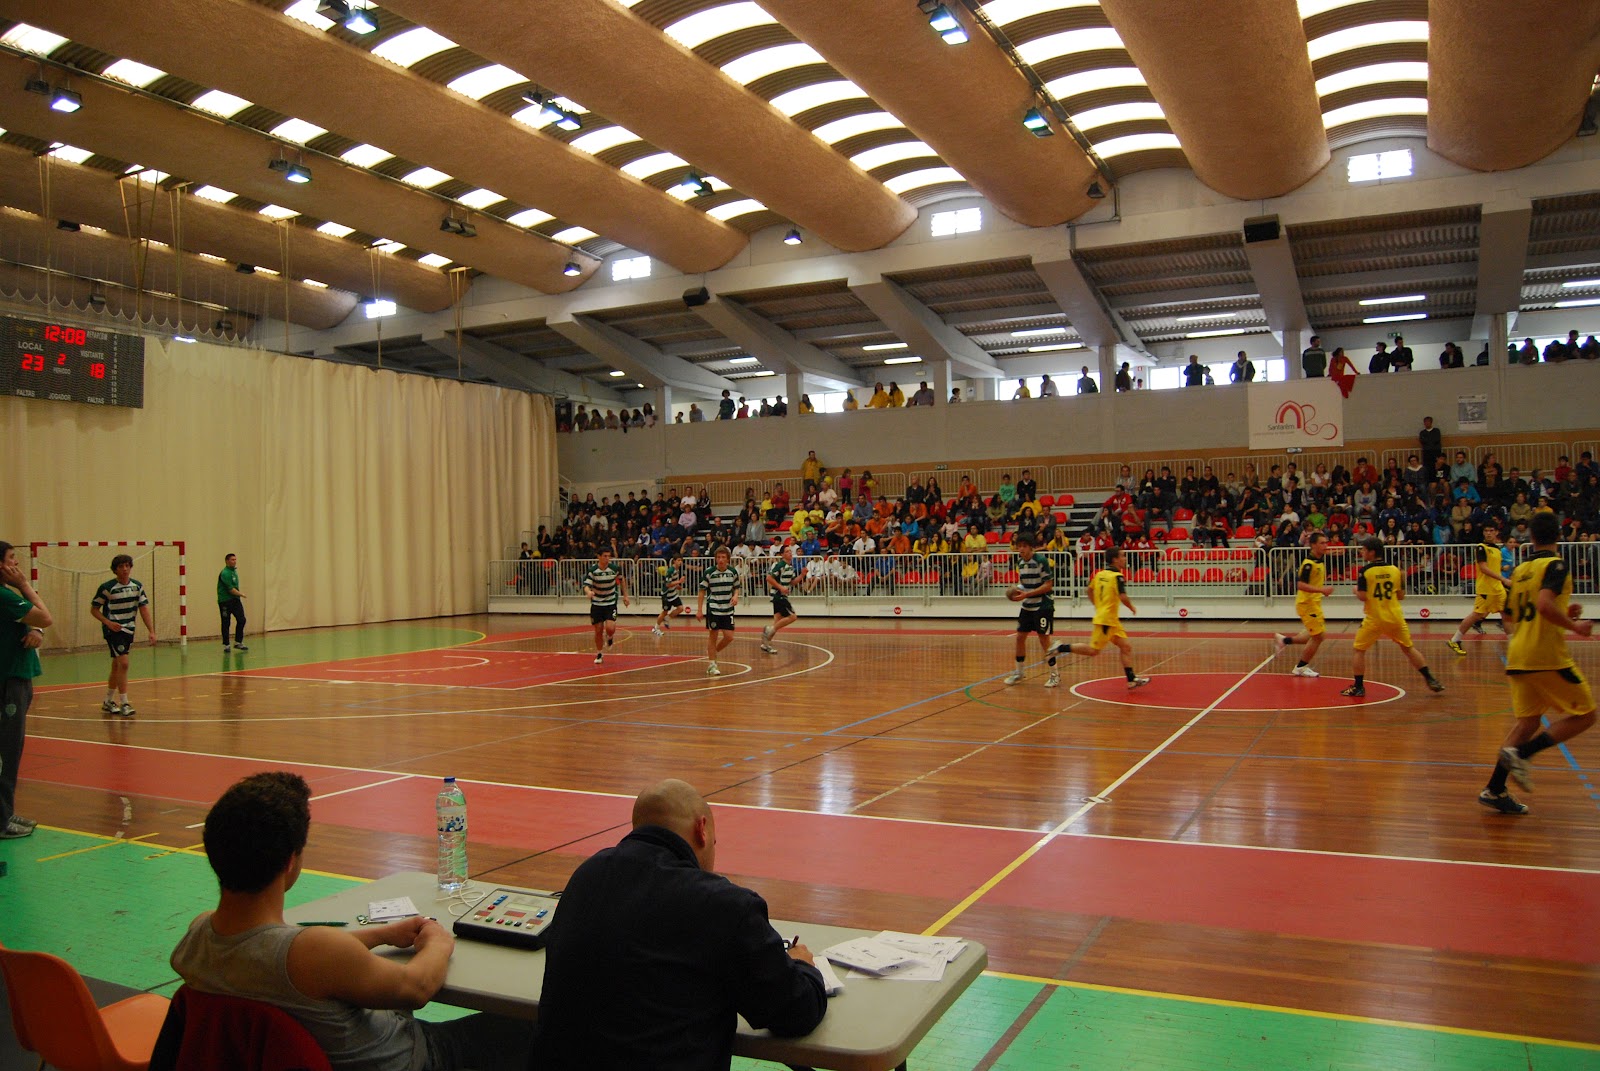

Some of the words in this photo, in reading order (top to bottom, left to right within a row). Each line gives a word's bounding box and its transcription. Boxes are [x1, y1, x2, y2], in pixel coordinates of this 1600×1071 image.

[44, 325, 86, 346] 12:08
[18, 341, 44, 351] LOCAL
[57, 353, 67, 365] 2
[80, 350, 104, 360] VISITANTE
[21, 353, 45, 372] 23
[90, 363, 105, 379] 18
[16, 389, 36, 398] FALTAS
[48, 392, 71, 401] JOGADOR
[87, 396, 105, 405] FALTAS
[1374, 581, 1393, 601] 48
[1040, 617, 1047, 628] 9
